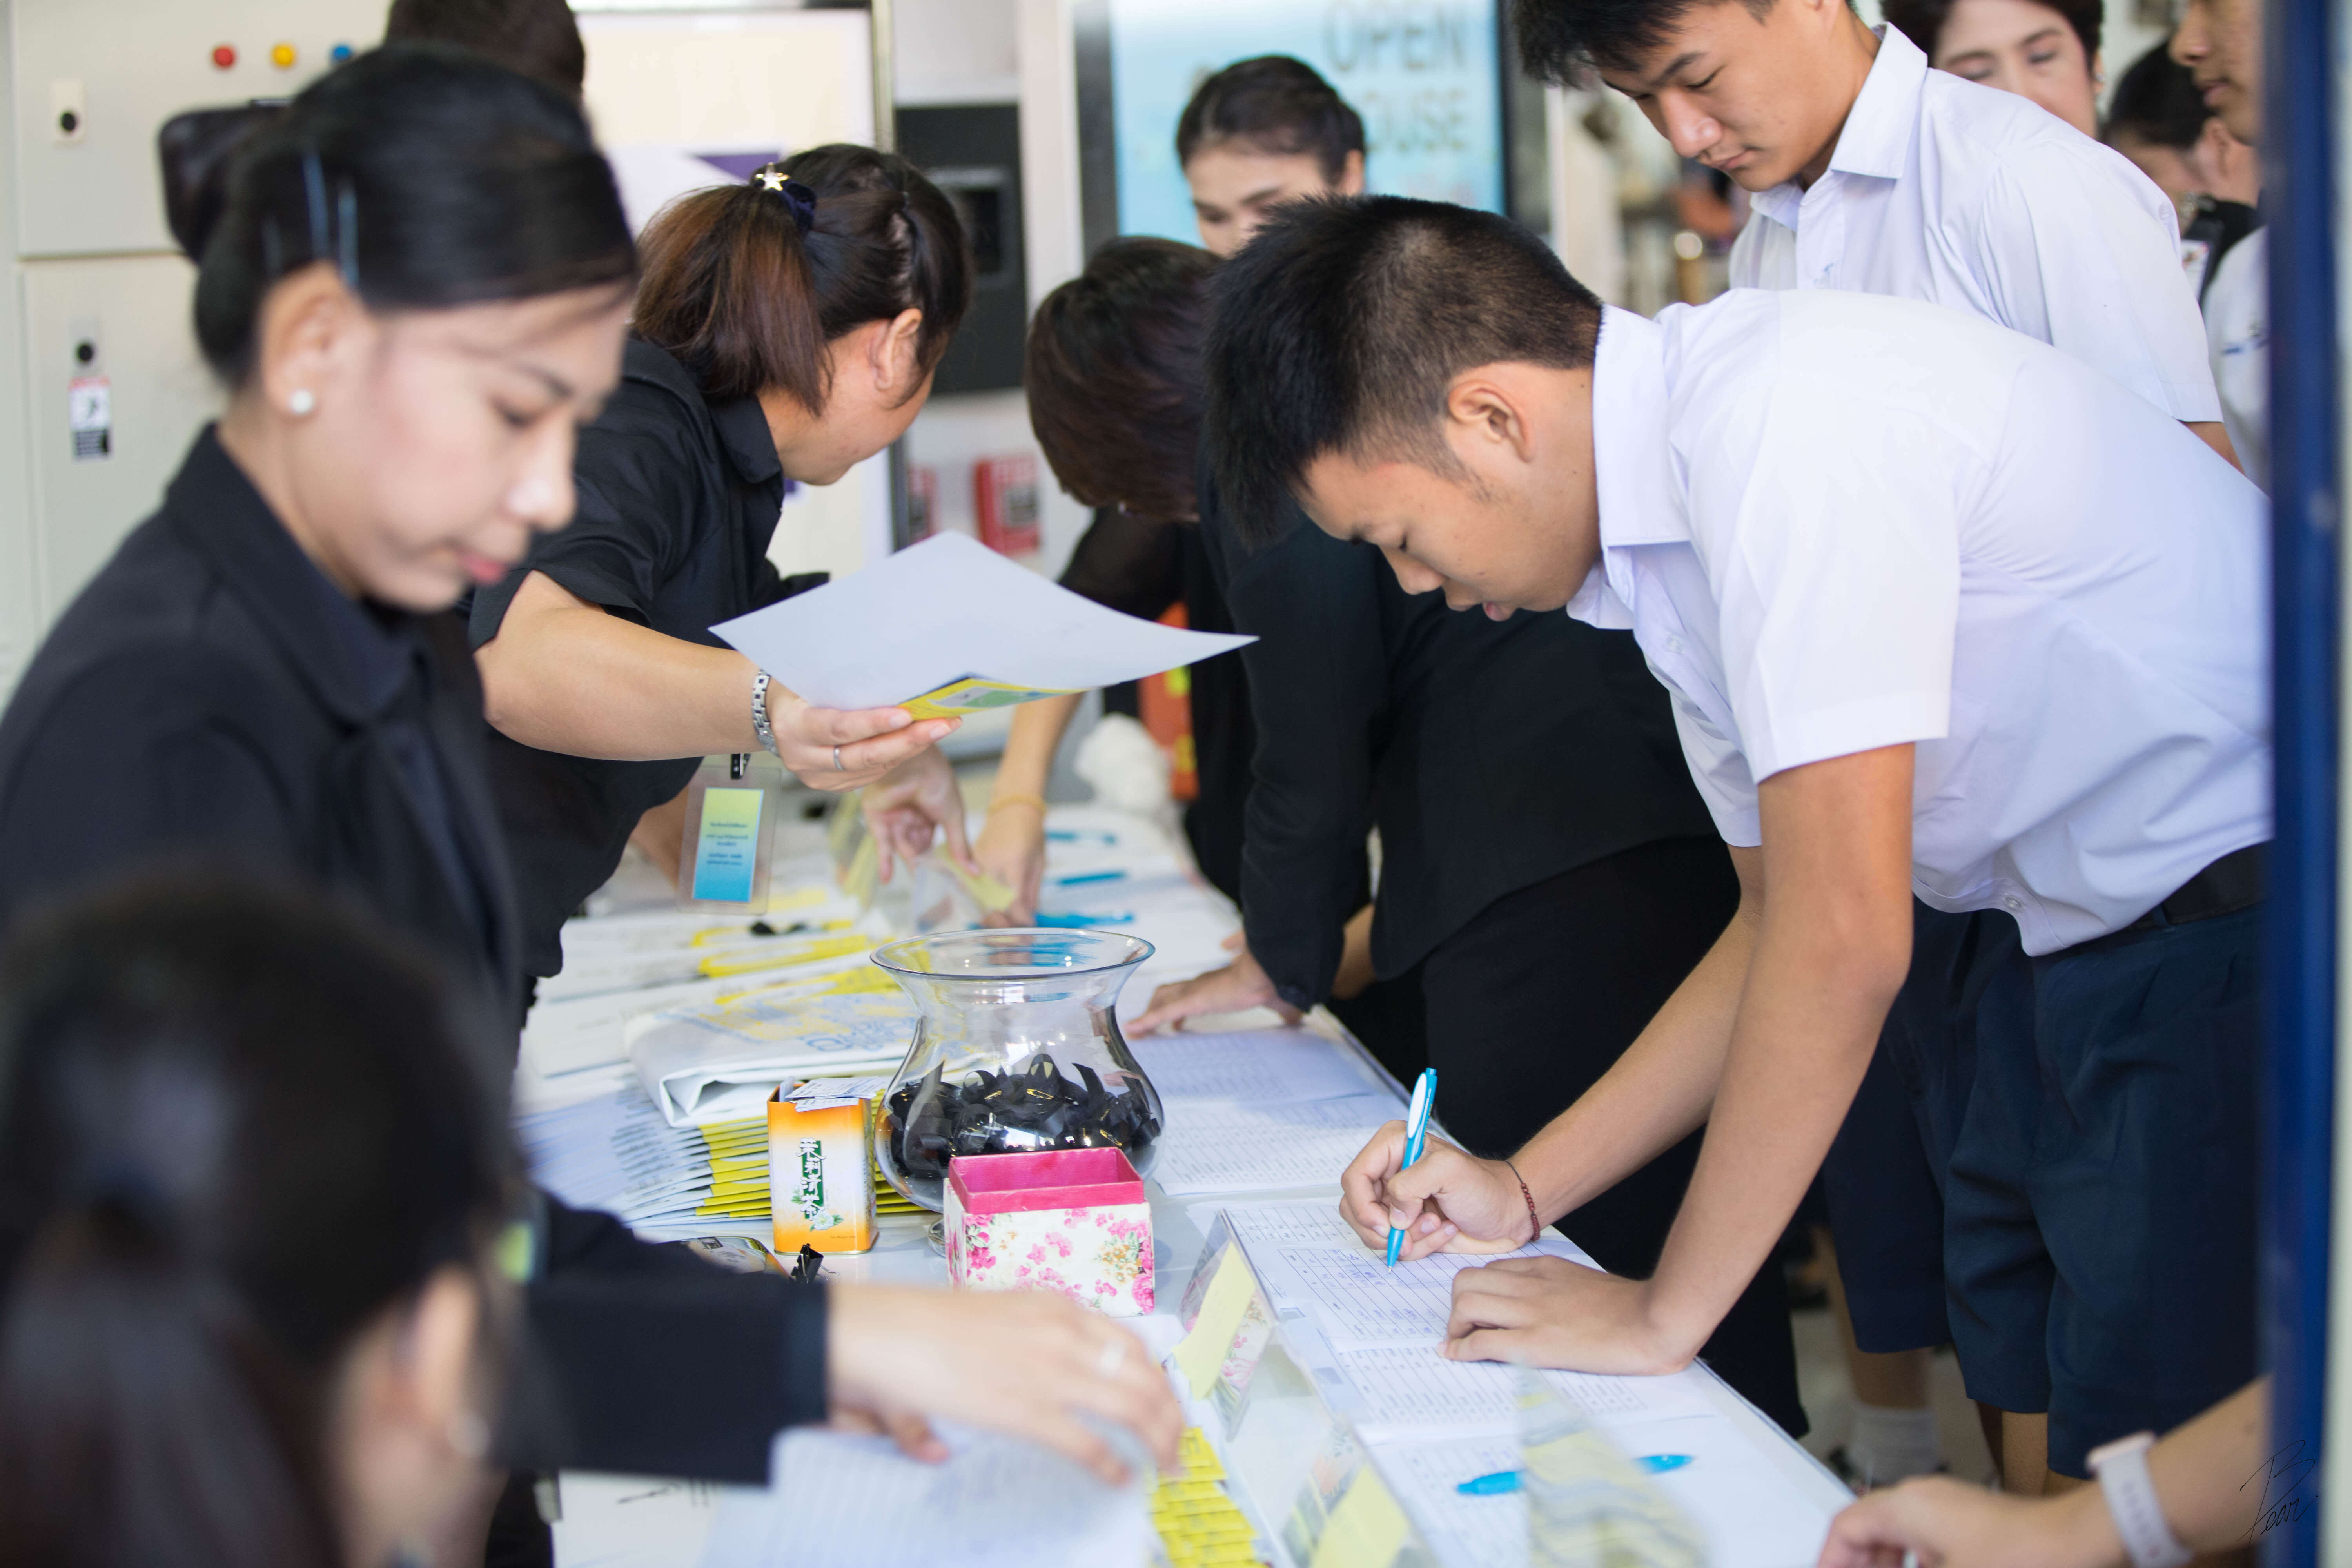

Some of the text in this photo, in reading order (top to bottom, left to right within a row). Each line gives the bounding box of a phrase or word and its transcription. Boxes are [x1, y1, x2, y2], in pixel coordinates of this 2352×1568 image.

[1323, 1, 1467, 72] OPEN
[1360, 89, 1467, 151] OUSE
[796, 1137, 826, 1221] 茉莉清茶
